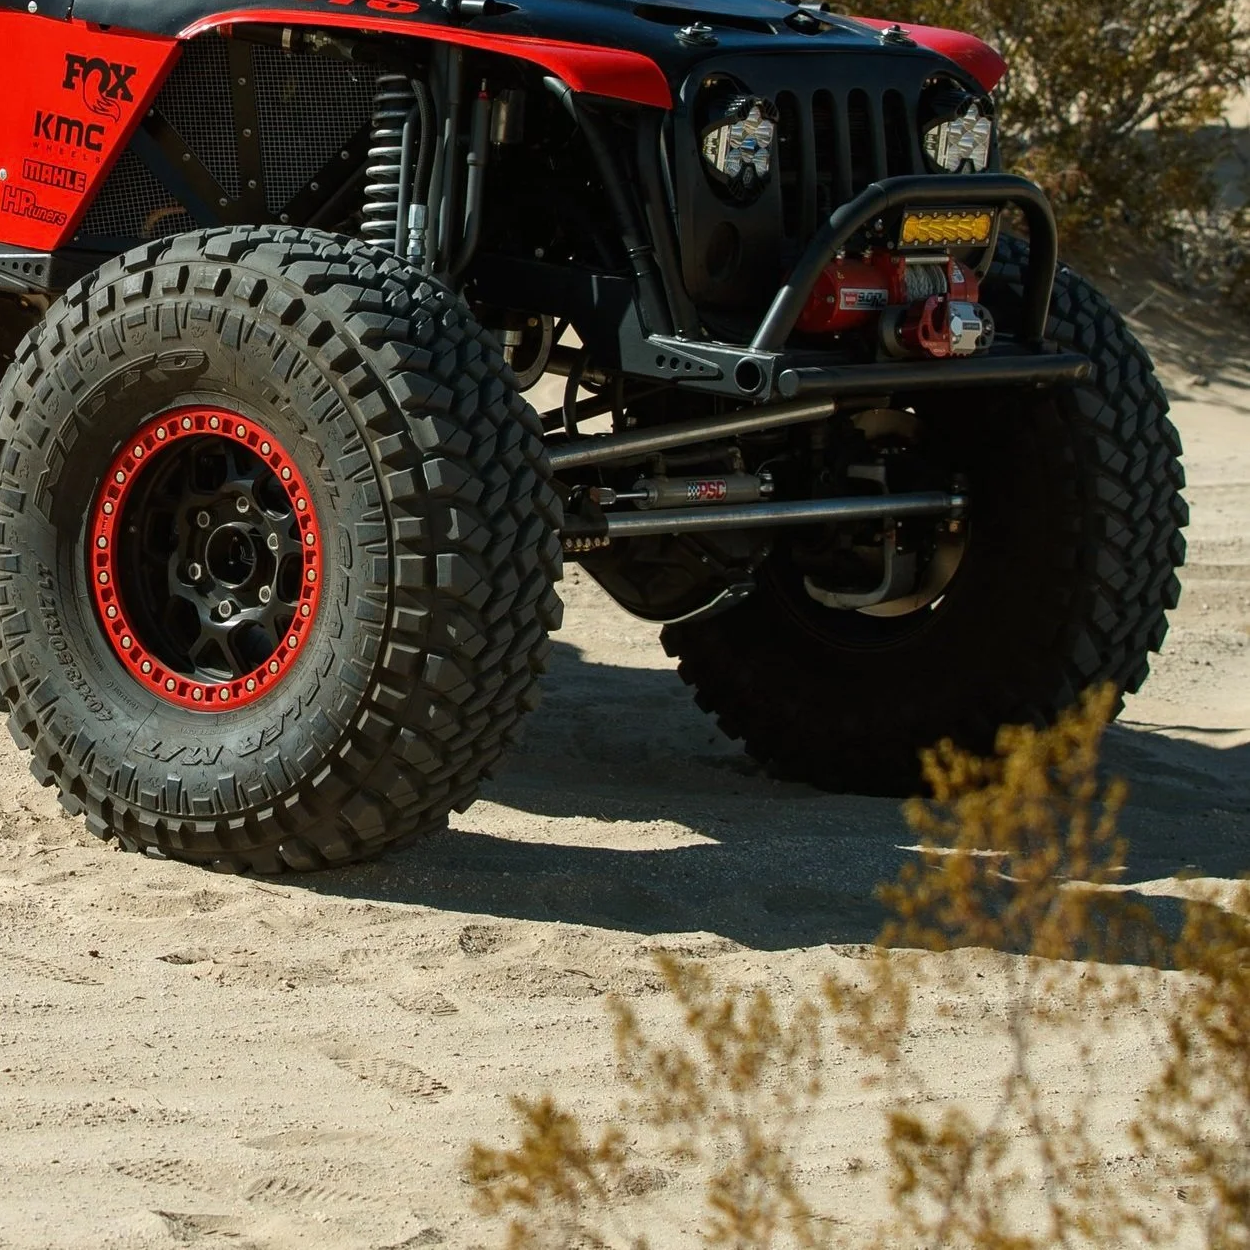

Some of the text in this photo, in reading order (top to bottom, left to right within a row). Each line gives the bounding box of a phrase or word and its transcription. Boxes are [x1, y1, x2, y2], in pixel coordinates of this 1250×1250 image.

[62, 53, 137, 105] FOX
[32, 140, 101, 164] WHEELS
[24, 159, 86, 193] MAHLE
